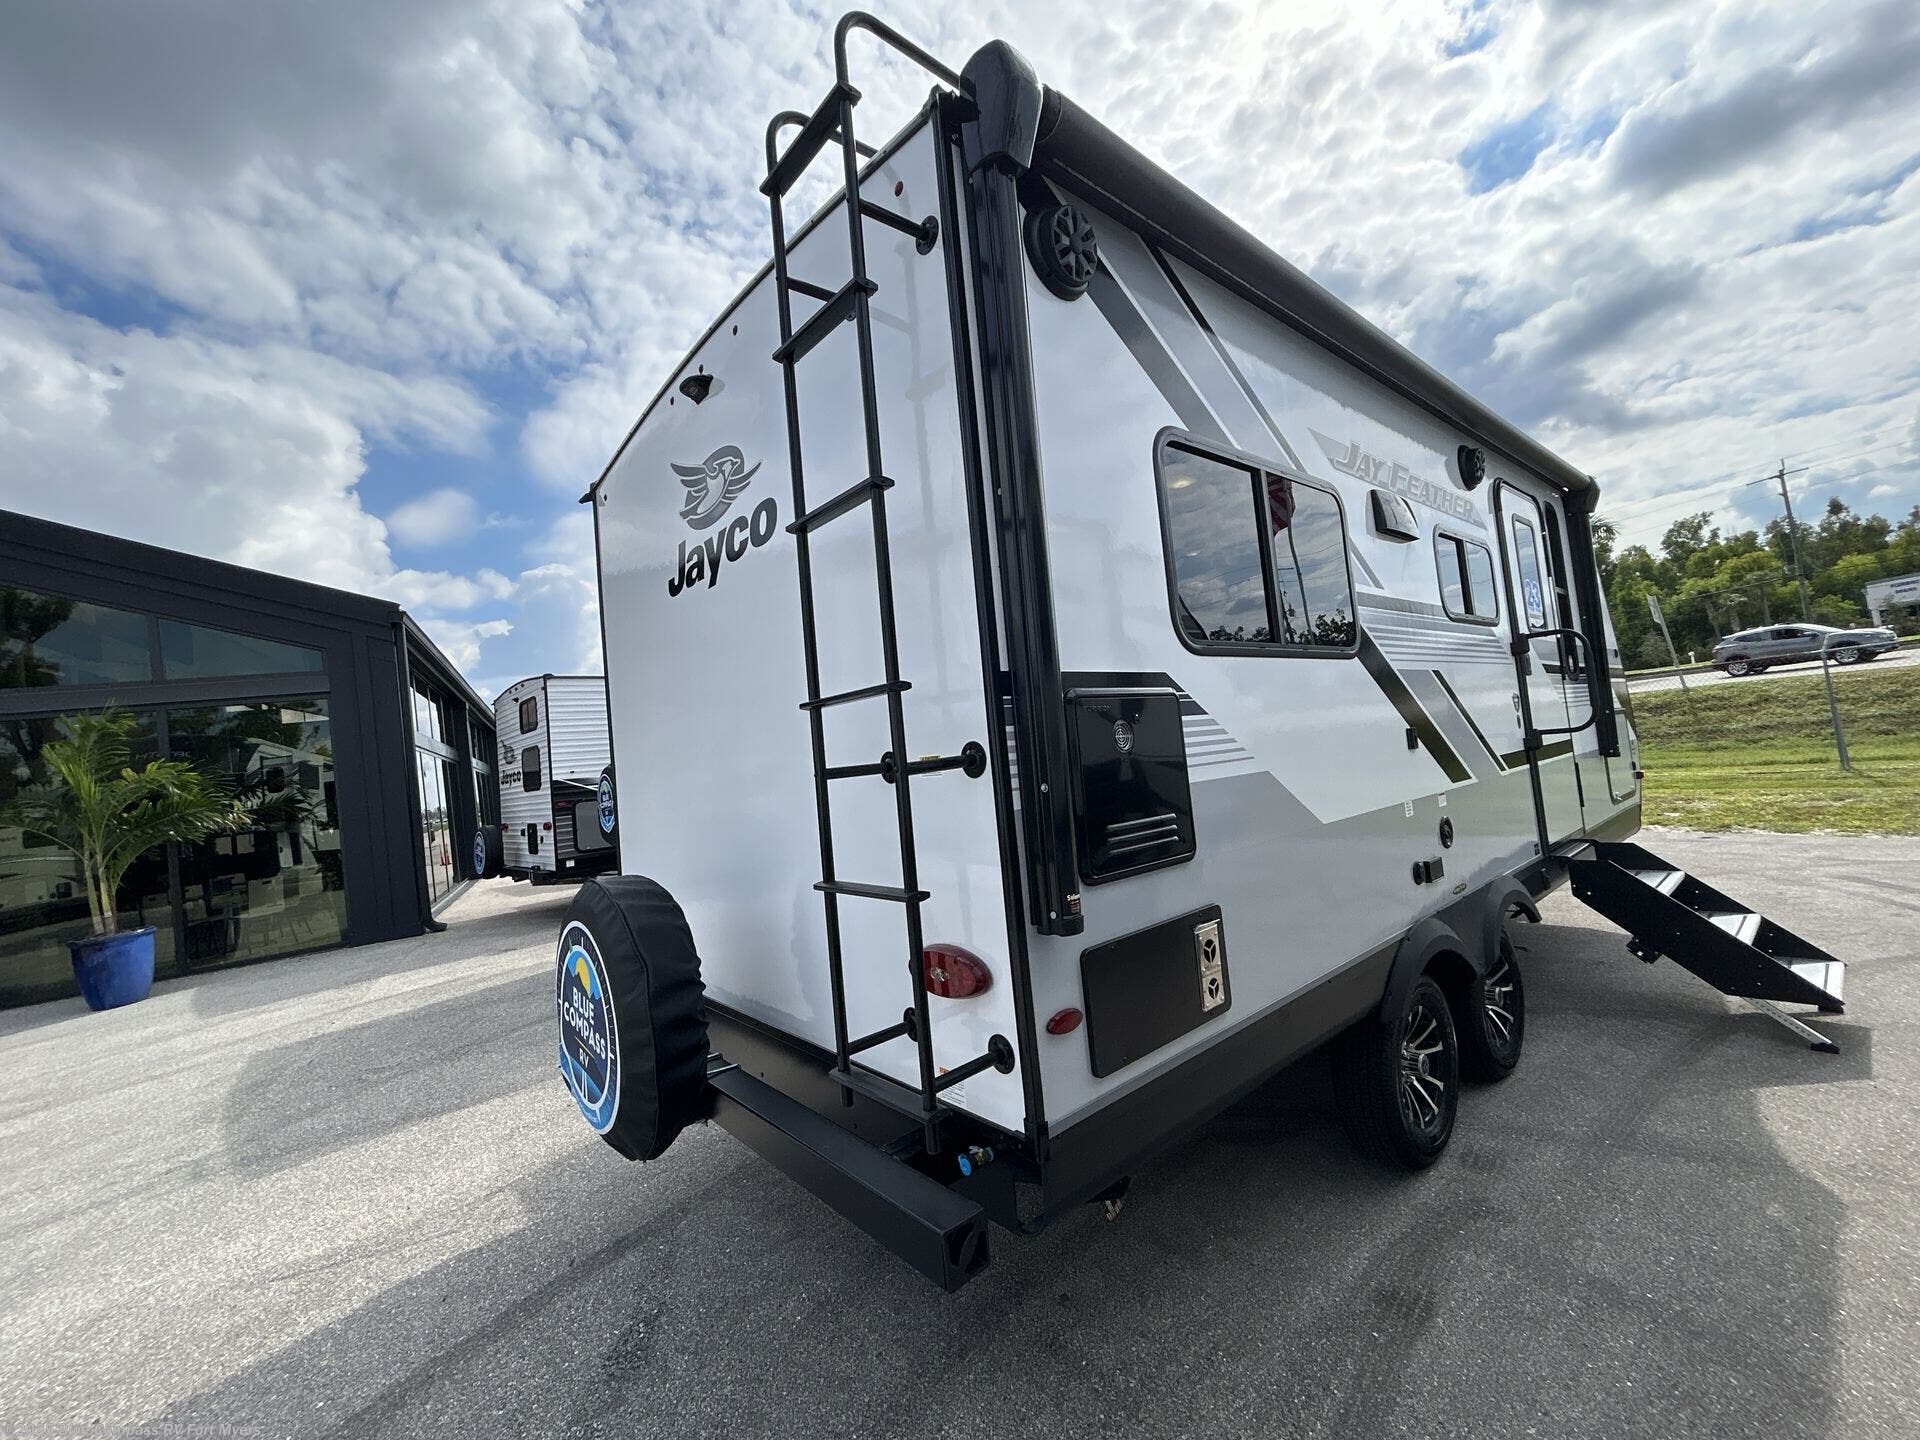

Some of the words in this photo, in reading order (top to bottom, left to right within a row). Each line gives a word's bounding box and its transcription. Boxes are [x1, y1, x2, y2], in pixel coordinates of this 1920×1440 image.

[1333, 440, 1394, 485] JAY
[1389, 460, 1475, 518] FEATHER
[668, 497, 777, 597] Jayco
[500, 769, 521, 786] Jayco
[563, 1001, 606, 1060] COMPASS
[573, 986, 595, 1026] BLUE
[579, 1047, 589, 1068] RV
